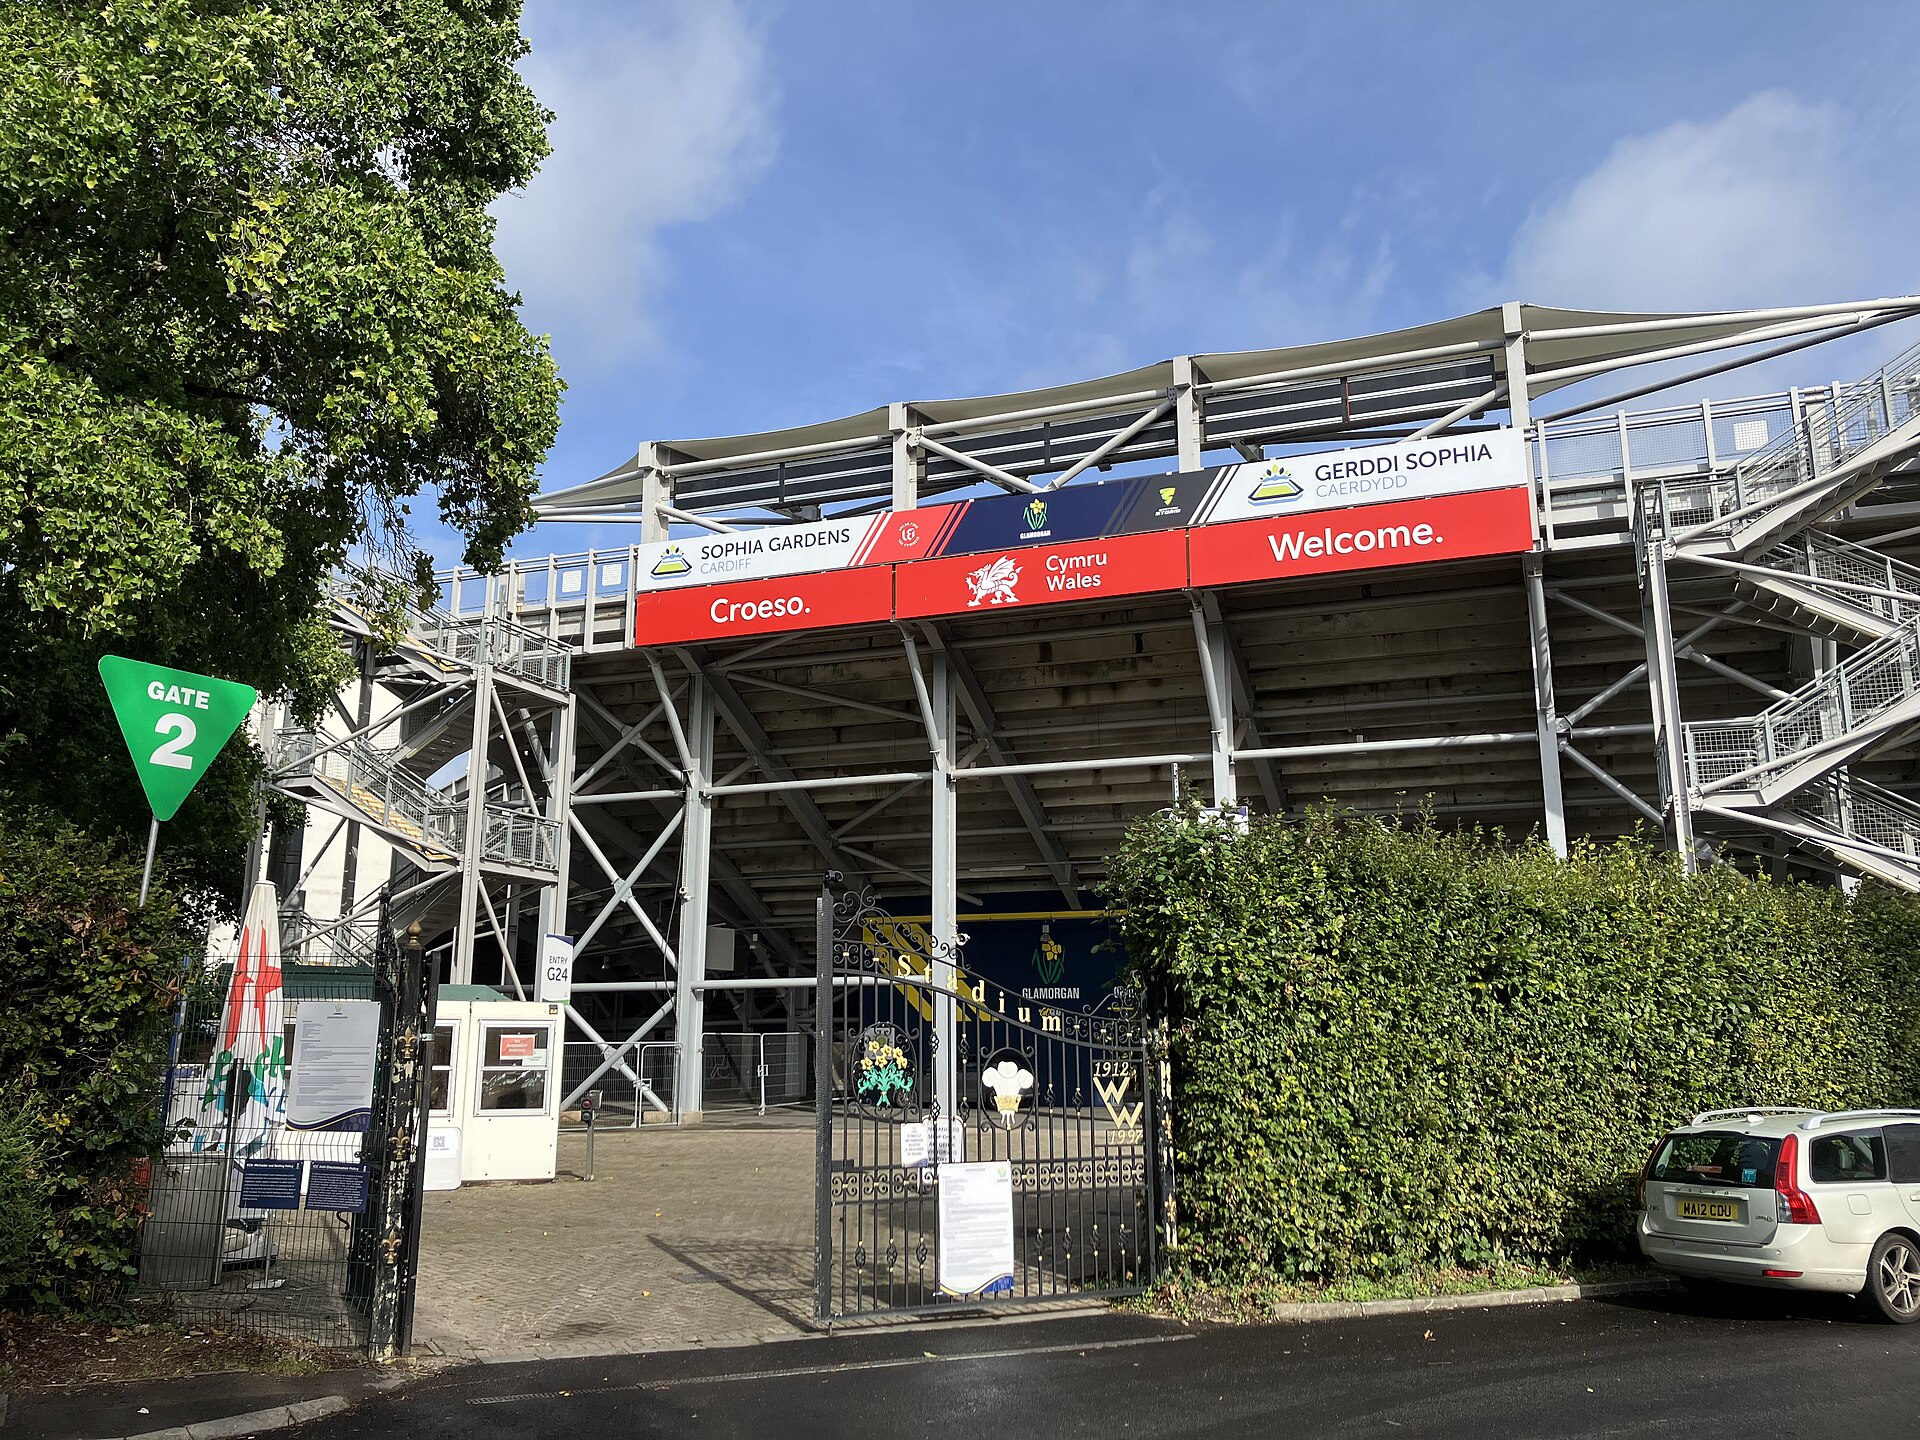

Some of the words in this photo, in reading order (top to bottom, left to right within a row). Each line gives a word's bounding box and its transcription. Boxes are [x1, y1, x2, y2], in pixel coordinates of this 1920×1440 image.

[1315, 458, 1398, 481] GERDDI
[1405, 443, 1492, 470] SOPHIA
[1316, 475, 1408, 497] CAERDYDD
[701, 540, 763, 560] SOPHIA
[769, 528, 850, 552] GARDENS
[1267, 522, 1444, 562] Welcome.
[700, 558, 751, 575] CARDIFF
[1046, 552, 1107, 573] Cymru
[1046, 572, 1101, 592] Wales
[710, 596, 811, 624] Croeso.
[147, 681, 210, 709] GATE
[150, 713, 197, 770] 2
[549, 956, 568, 964] ENTRY
[547, 967, 568, 981] G24
[898, 955, 1061, 1031] Stadium
[1022, 988, 1080, 999] GLAMORGAN
[1093, 1062, 1129, 1077] 1912
[1110, 1129, 1143, 1145] 1997
[1683, 1203, 1707, 1216] MA12
[1710, 1204, 1731, 1217] CDU
